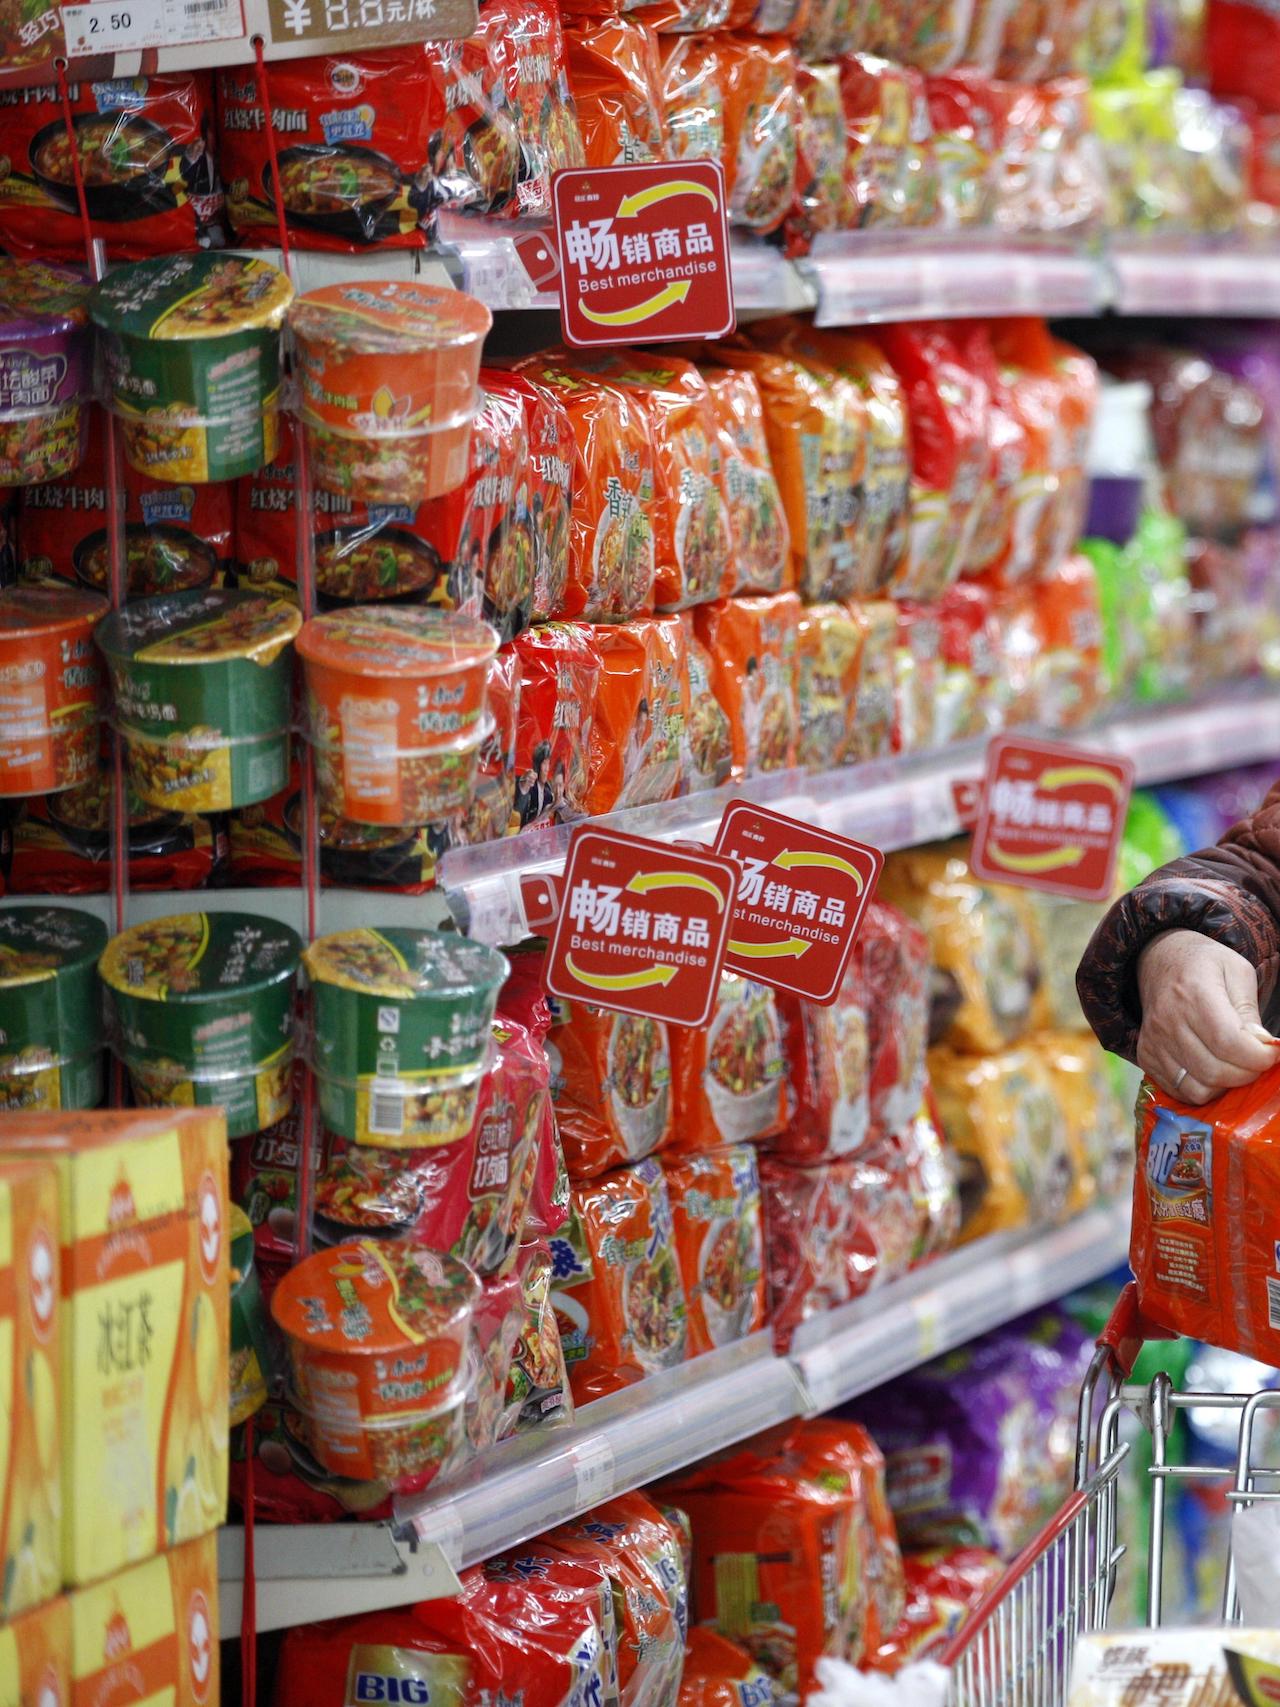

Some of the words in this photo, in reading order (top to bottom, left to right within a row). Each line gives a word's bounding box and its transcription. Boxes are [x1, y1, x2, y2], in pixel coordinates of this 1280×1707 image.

[89, 13, 131, 33] 2.50
[565, 217, 714, 275] 畅销商品
[578, 277, 614, 293] Best
[617, 261, 717, 287] merchandise
[569, 879, 710, 949] 畅销商品
[748, 912, 840, 946] merchandise
[571, 935, 605, 952] Best
[608, 942, 707, 967] merchandise
[358, 1672, 429, 1703] BIG
